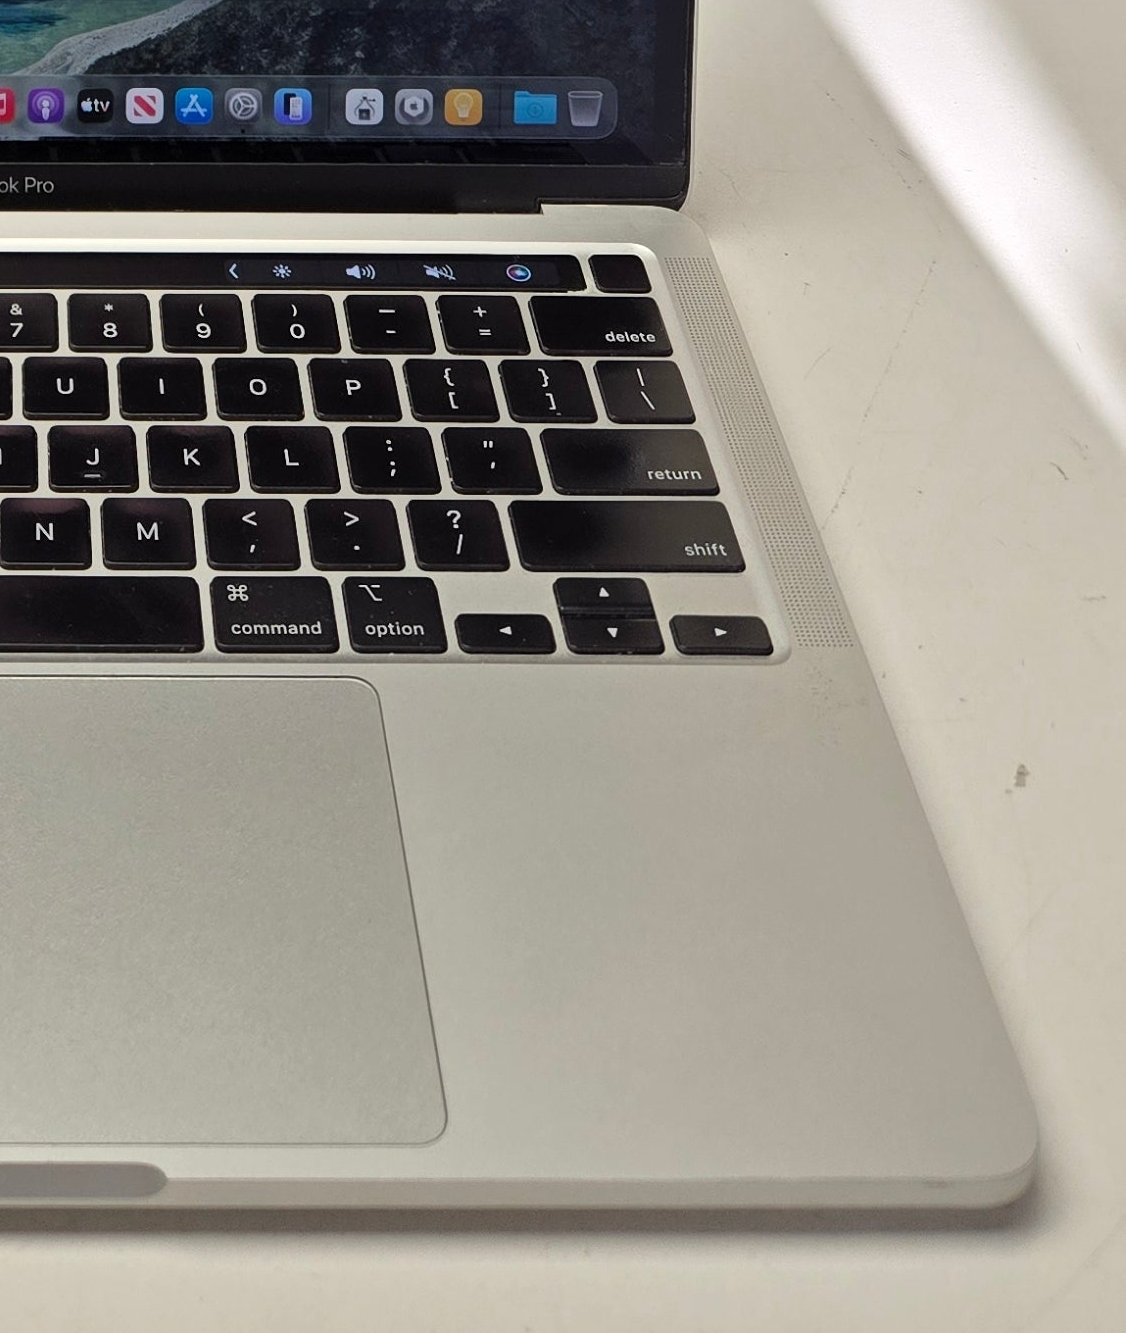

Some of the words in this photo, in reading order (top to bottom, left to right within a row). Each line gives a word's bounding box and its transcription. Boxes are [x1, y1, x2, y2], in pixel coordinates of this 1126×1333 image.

[25, 177, 54, 193] Pro
[9, 323, 24, 339] 7
[102, 323, 118, 339] 8
[195, 323, 211, 339] 9
[289, 323, 305, 339] 0
[604, 329, 656, 344] delete
[57, 378, 74, 396] U
[249, 378, 267, 396] O
[346, 379, 361, 396] P
[86, 448, 99, 467] J
[183, 448, 201, 466] K
[284, 448, 298, 466] L
[648, 467, 702, 481] return
[35, 522, 54, 541] N
[136, 522, 159, 541] M
[684, 541, 727, 557] shift
[231, 620, 322, 636] command
[365, 620, 424, 639] option
